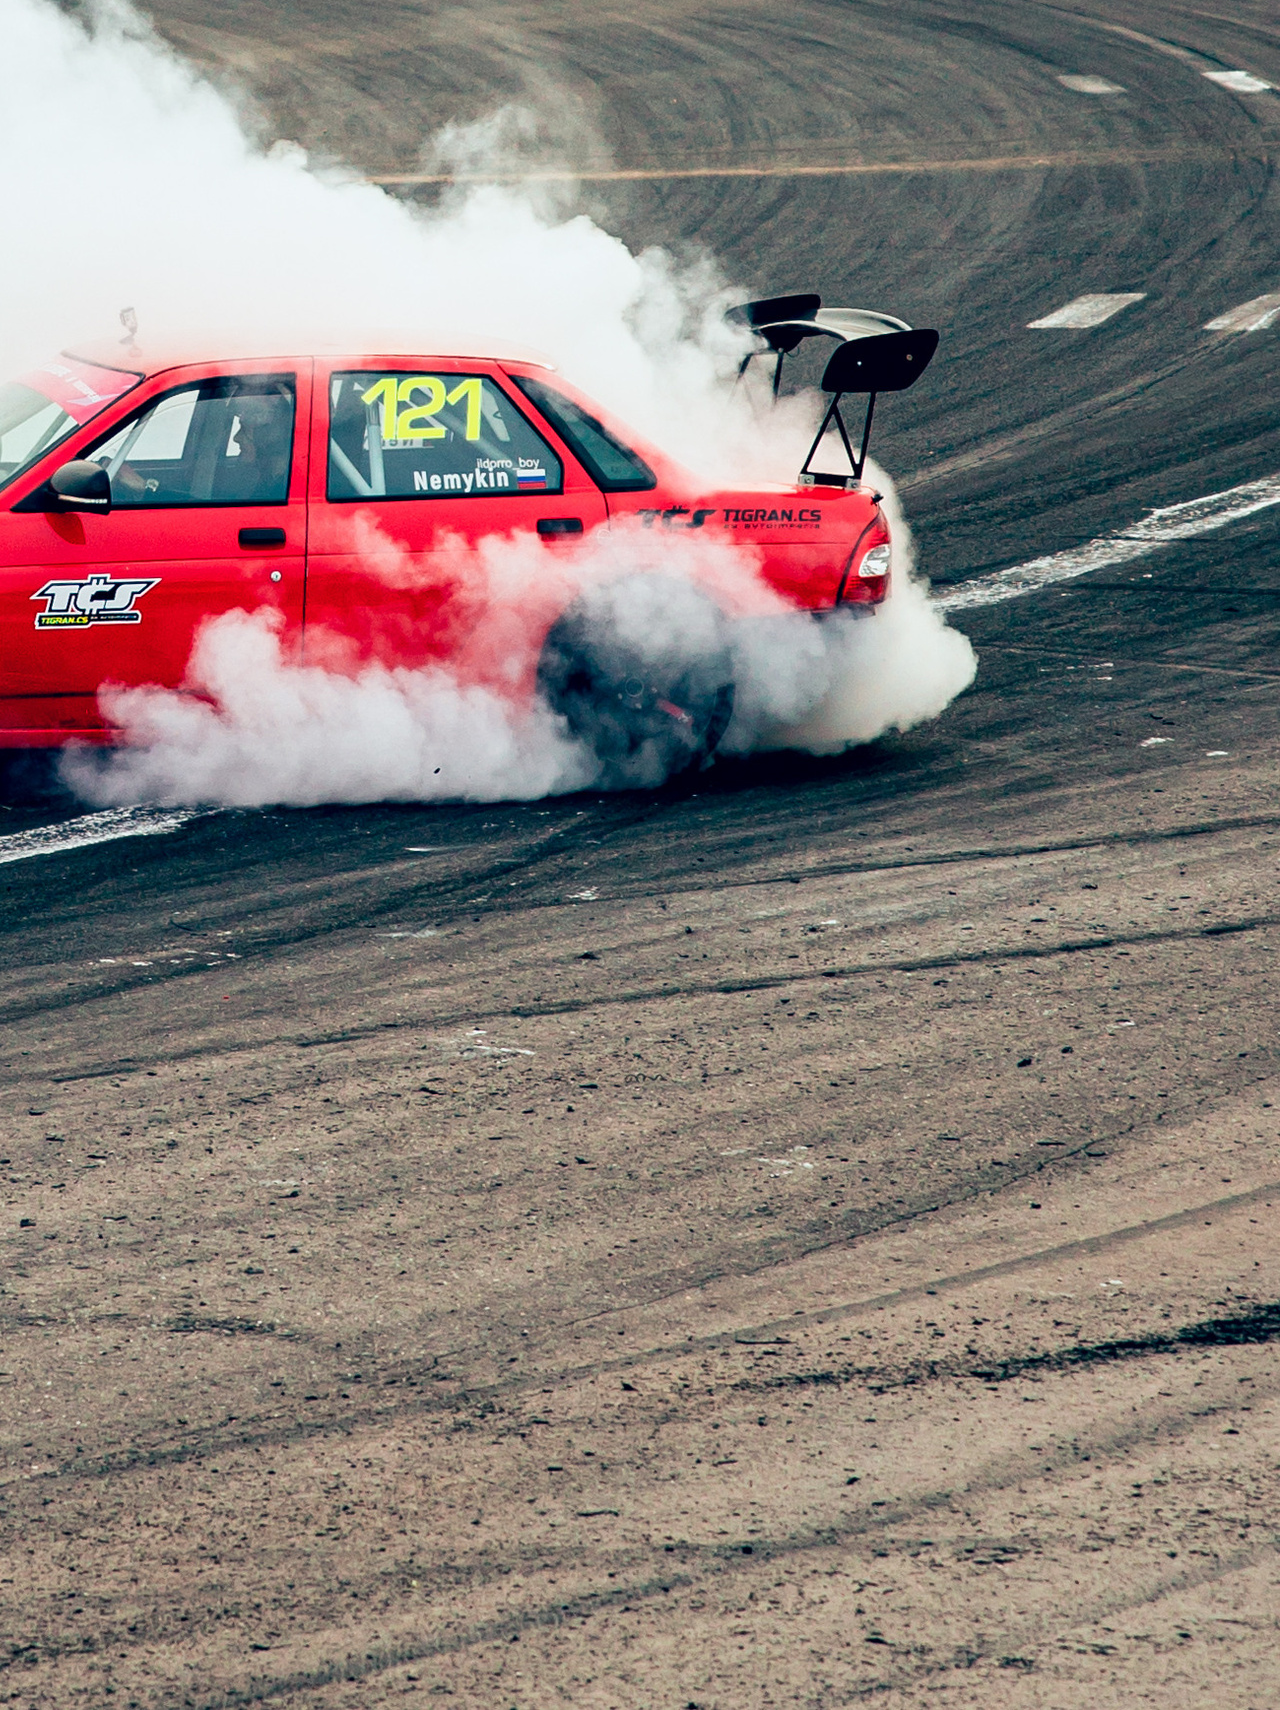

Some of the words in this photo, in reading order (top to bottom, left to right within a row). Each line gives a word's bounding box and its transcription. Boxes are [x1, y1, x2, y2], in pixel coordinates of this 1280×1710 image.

[361, 377, 482, 441] 121
[412, 468, 510, 492] Nemykin
[723, 509, 822, 522] TIGRAN.CS
[40, 616, 89, 625] TIGRAN.CS
